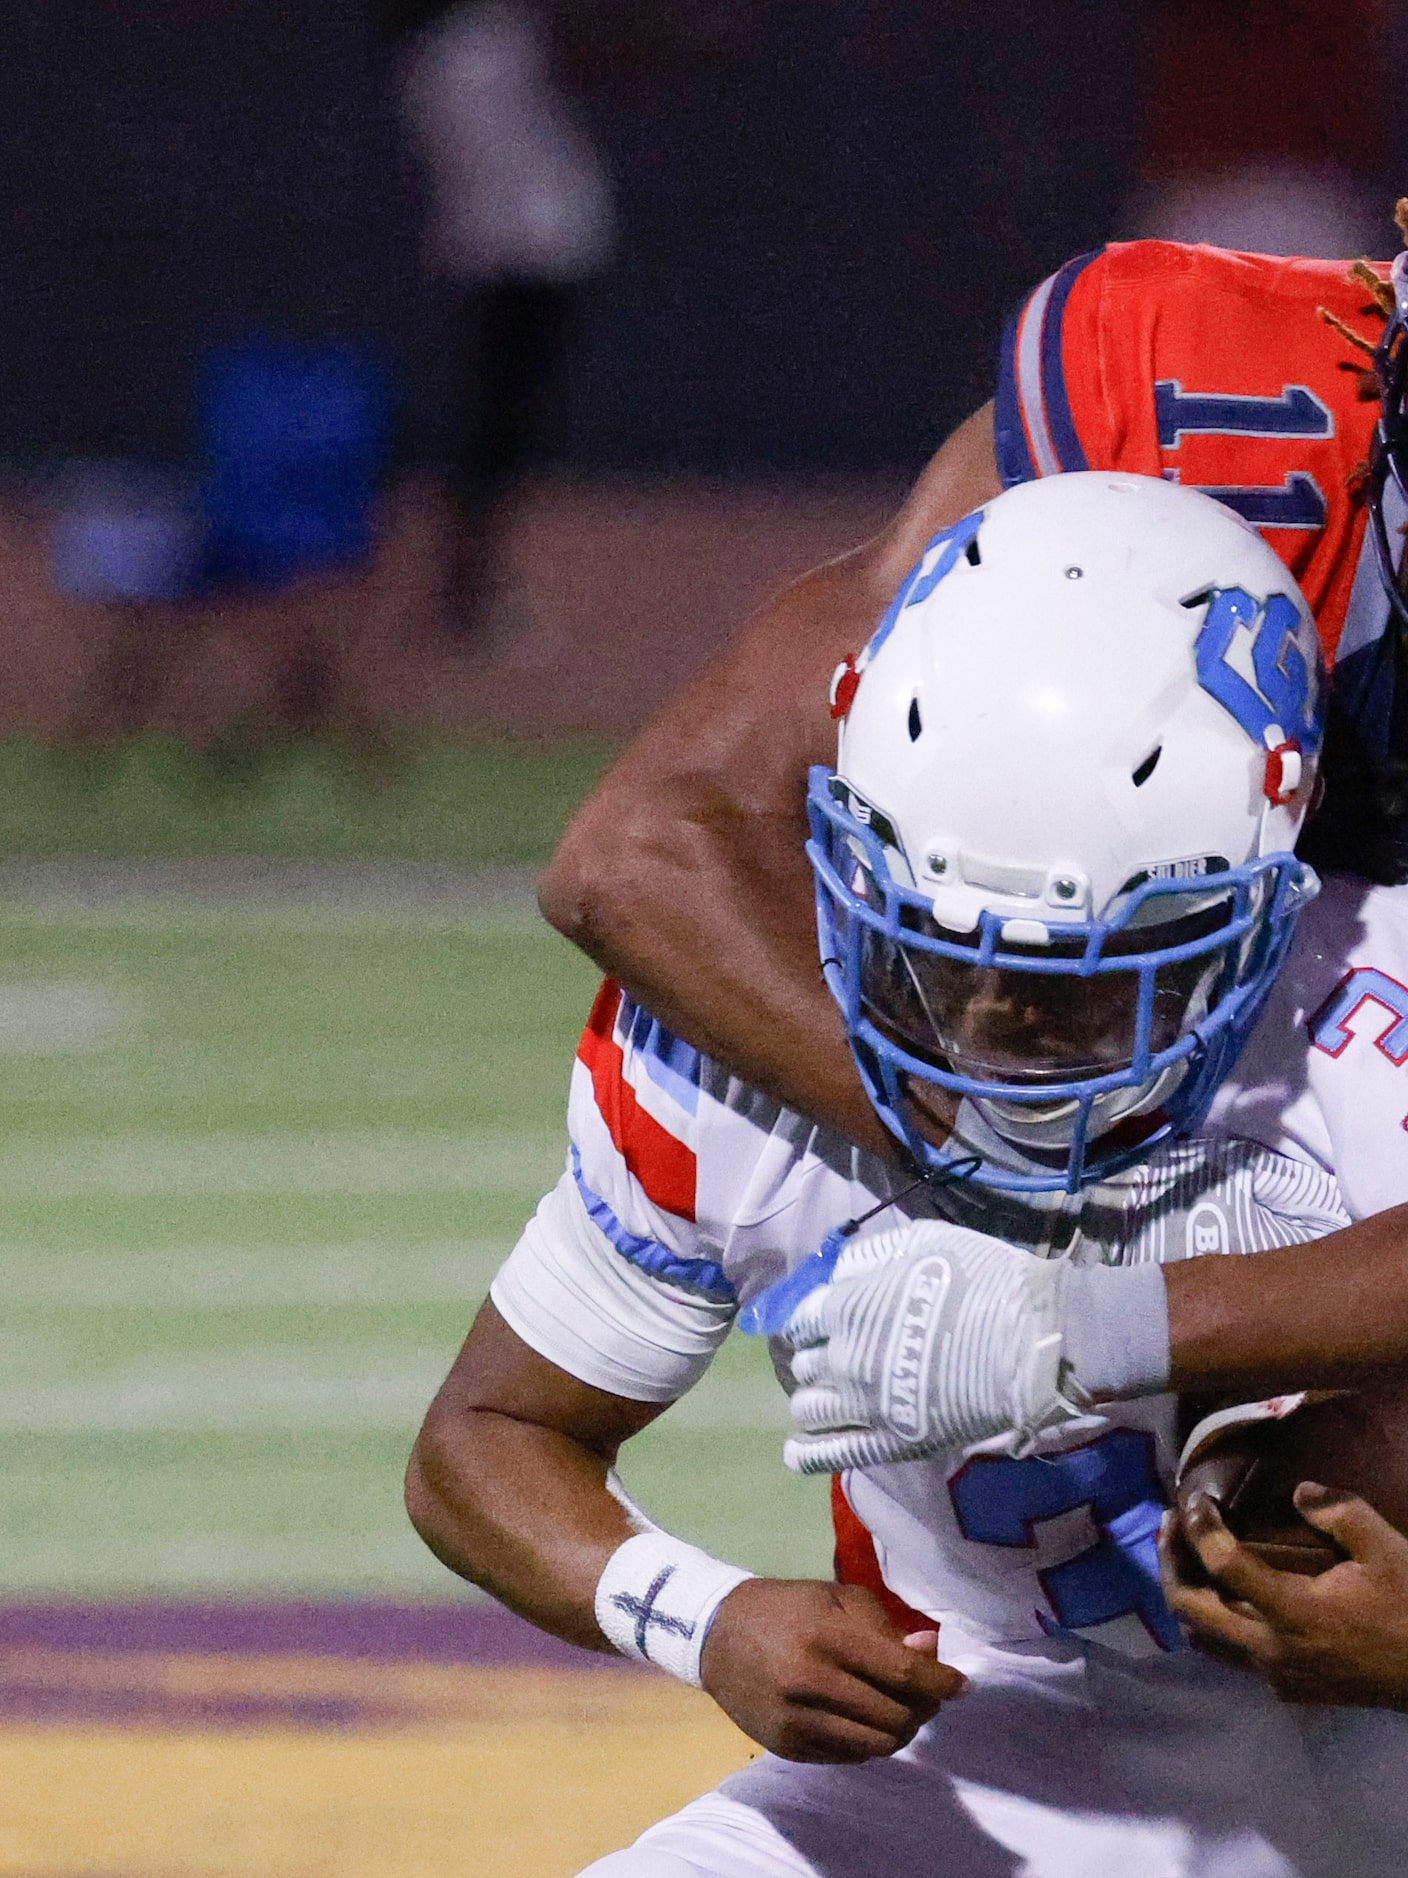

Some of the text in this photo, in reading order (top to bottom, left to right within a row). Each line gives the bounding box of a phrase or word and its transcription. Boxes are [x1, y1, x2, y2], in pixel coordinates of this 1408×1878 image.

[1154, 379, 1335, 529] 11
[890, 1272, 941, 1431] BATTLE
[946, 1426, 1186, 1655] 3
